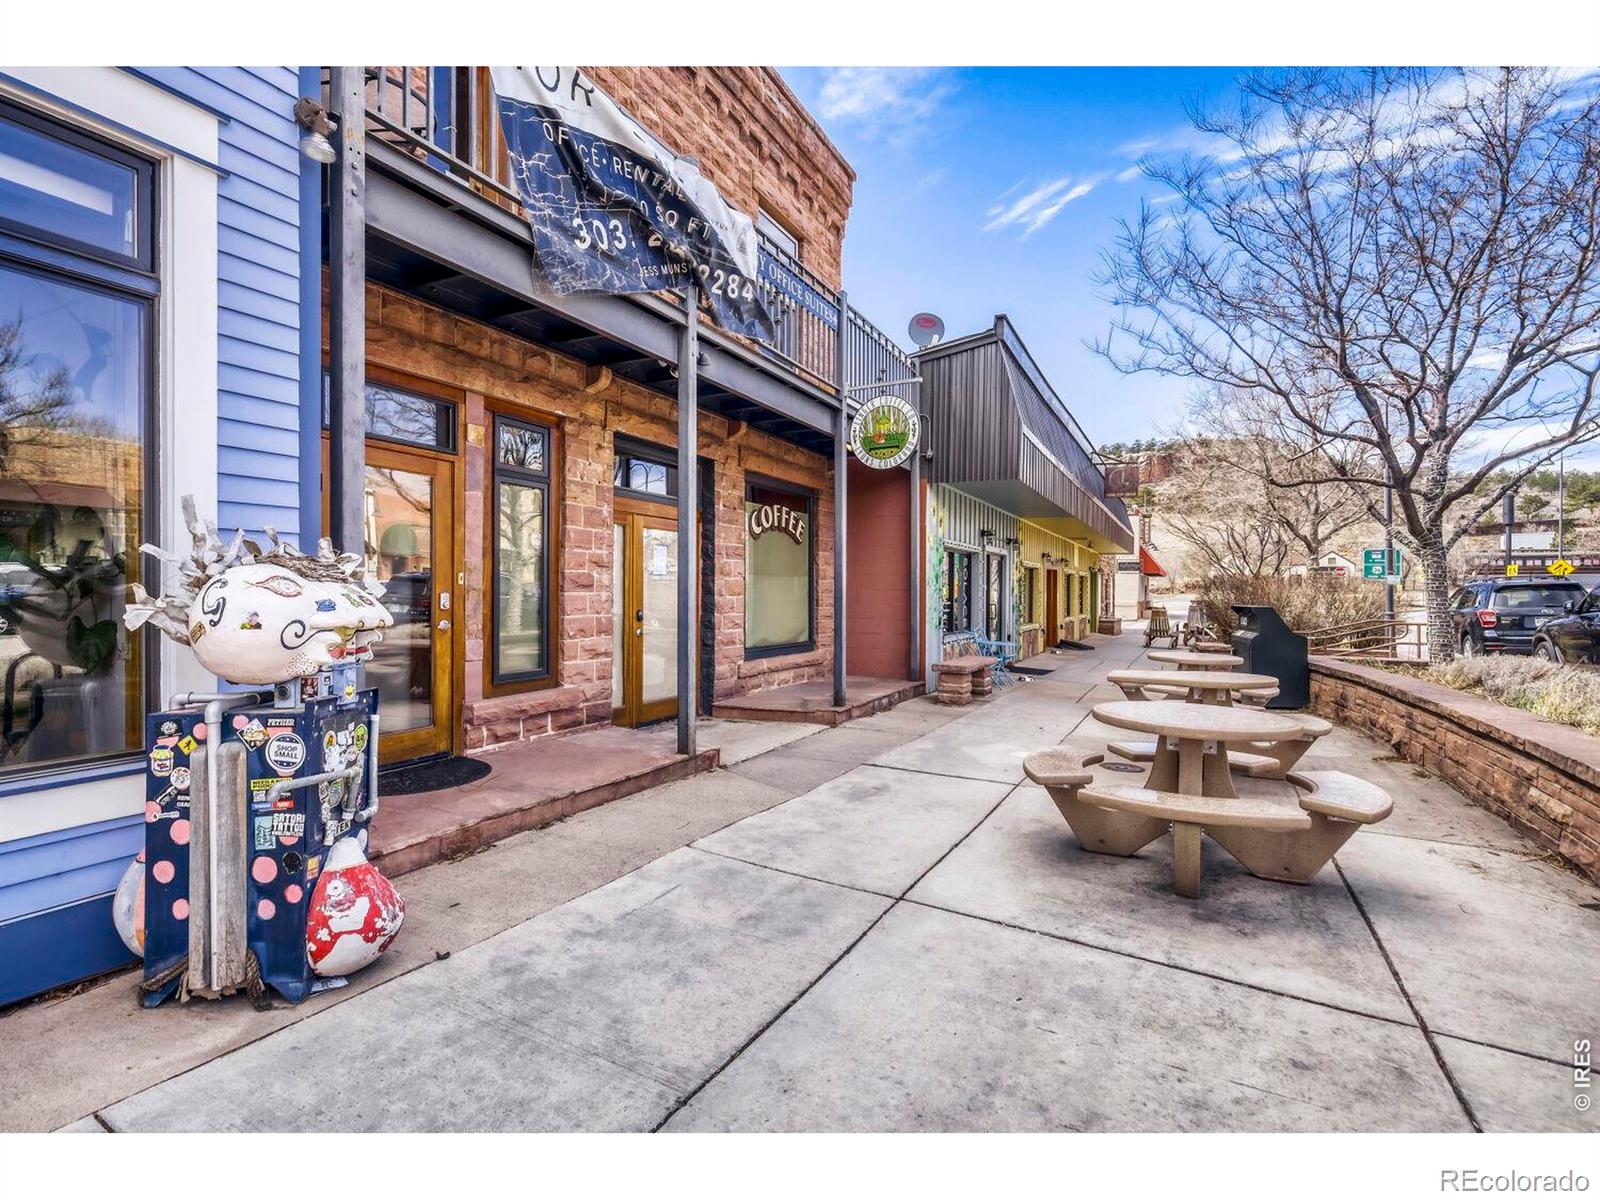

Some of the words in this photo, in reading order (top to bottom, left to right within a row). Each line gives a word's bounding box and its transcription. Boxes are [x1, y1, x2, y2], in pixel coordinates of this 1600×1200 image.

[517, 66, 595, 107] OR
[656, 205, 677, 229] SQ
[687, 216, 711, 241] FT
[768, 263, 804, 300] OFFICE
[804, 290, 833, 323] SUITES
[751, 504, 807, 544] COFFEE
[273, 751, 299, 760] SMALL
[276, 744, 298, 752] SHOP
[272, 822, 305, 832] TATTOO
